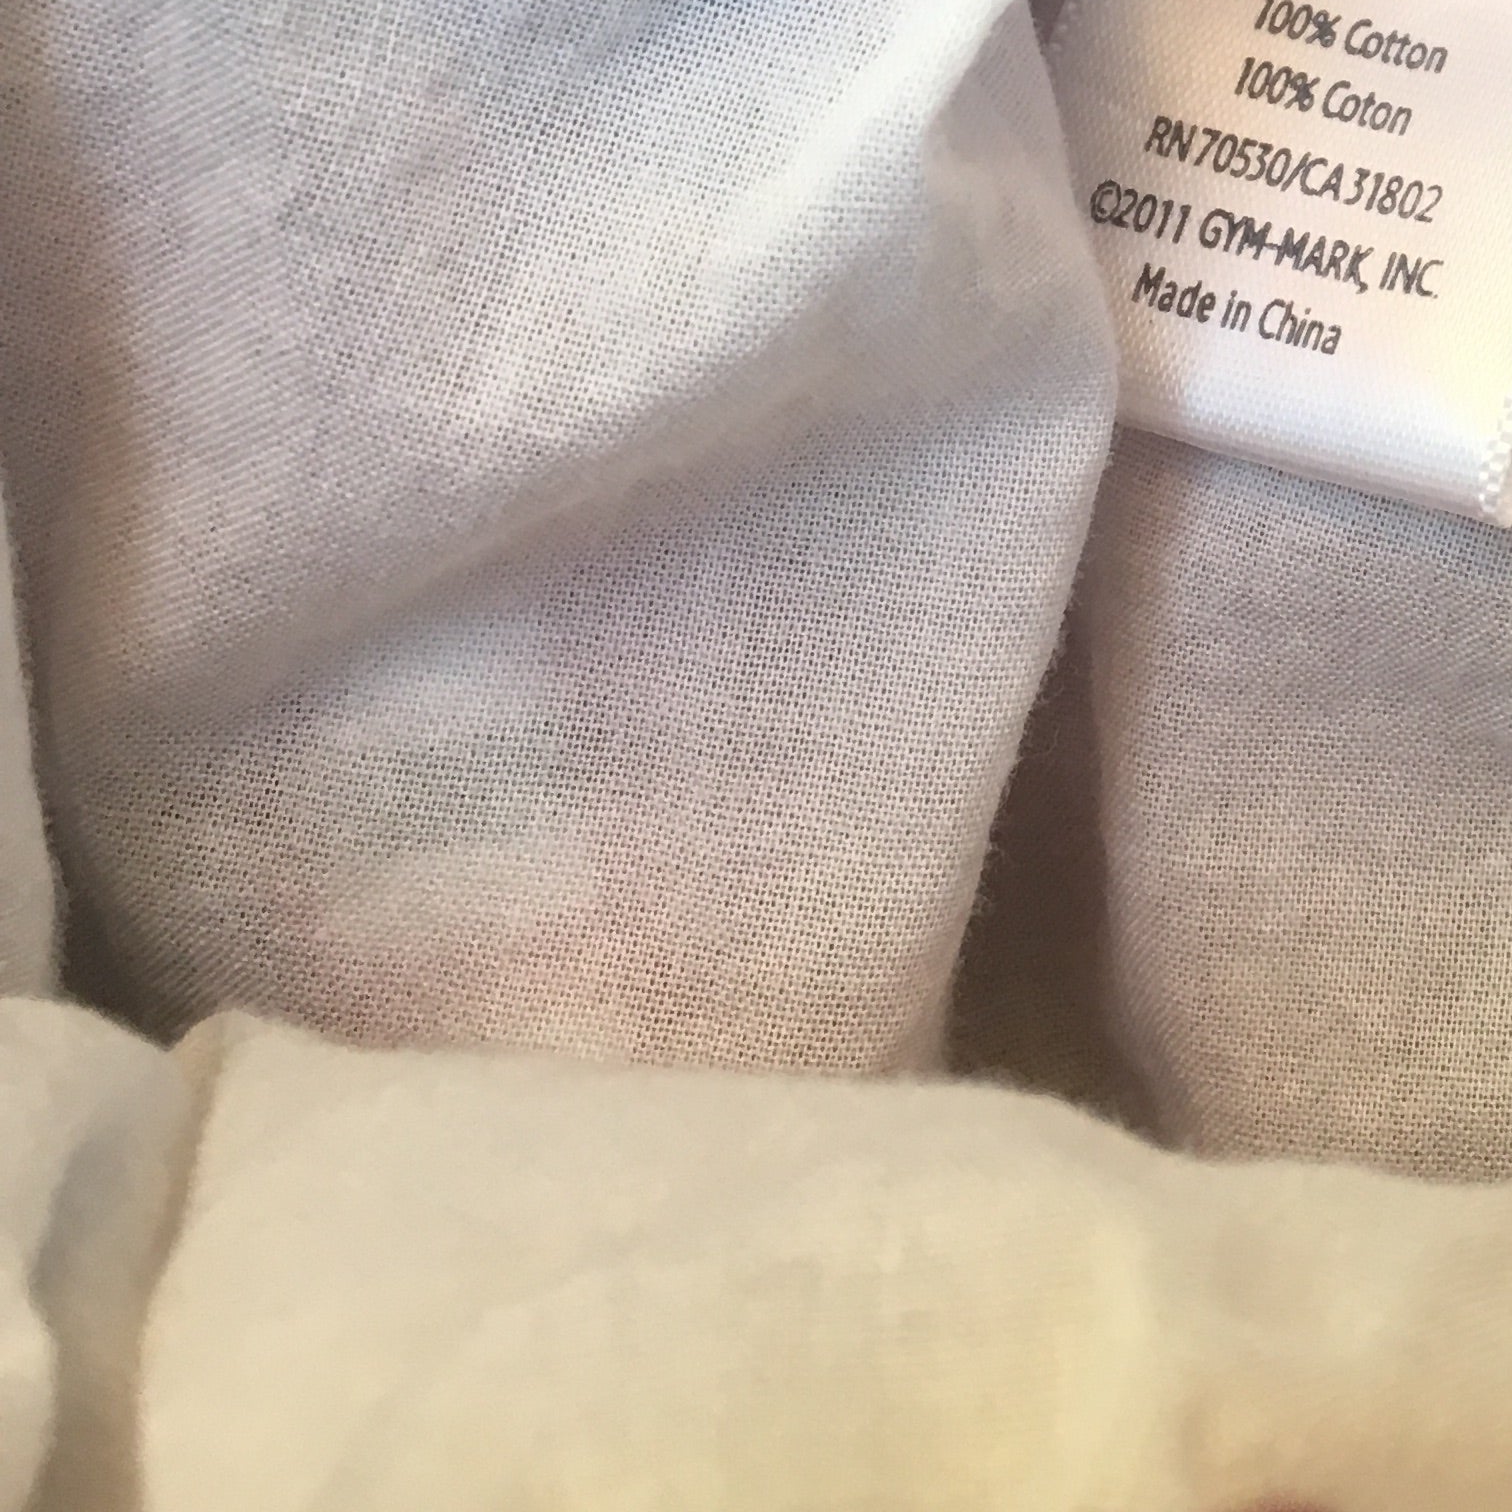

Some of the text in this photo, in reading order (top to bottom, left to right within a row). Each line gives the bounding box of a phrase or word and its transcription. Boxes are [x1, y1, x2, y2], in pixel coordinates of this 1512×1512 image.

[1344, 18, 1449, 74] Cotton
[1234, 57, 1413, 136] 100% Coton
[1199, 207, 1375, 294] GYM-MARK,
[1378, 251, 1445, 299] INC.
[1131, 262, 1343, 355] Made in China
